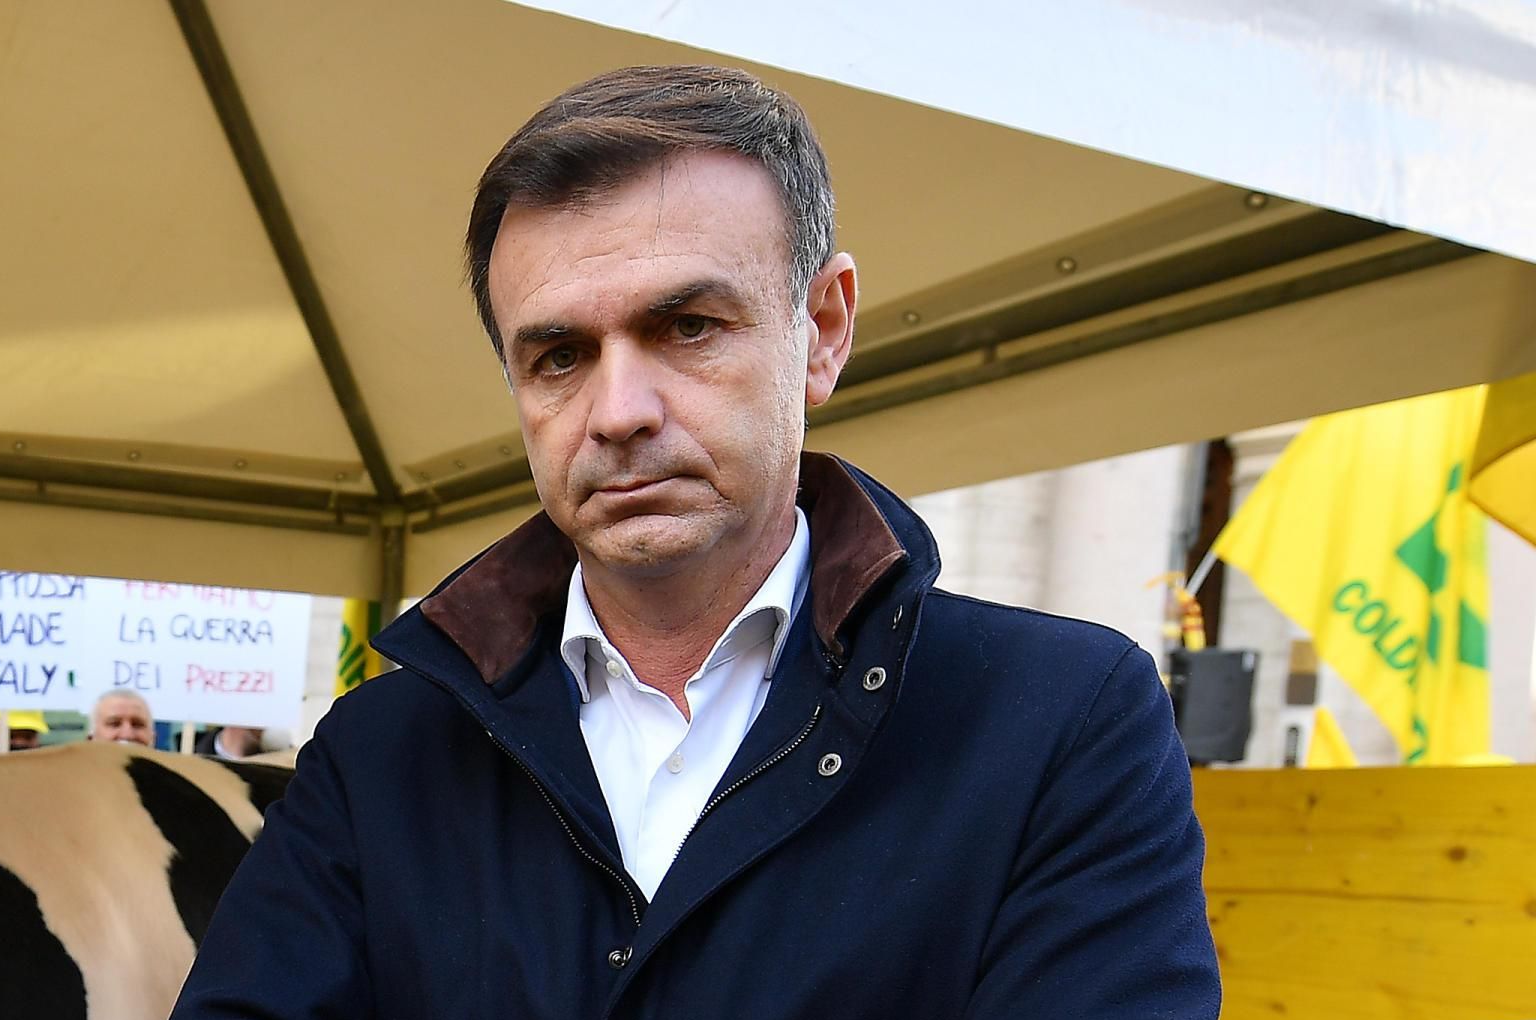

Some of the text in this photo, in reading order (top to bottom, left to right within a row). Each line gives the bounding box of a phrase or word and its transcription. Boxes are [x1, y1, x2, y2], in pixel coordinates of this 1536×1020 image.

[119, 614, 274, 645] LA GUERRA
[114, 660, 275, 694] DEI PREZZI
